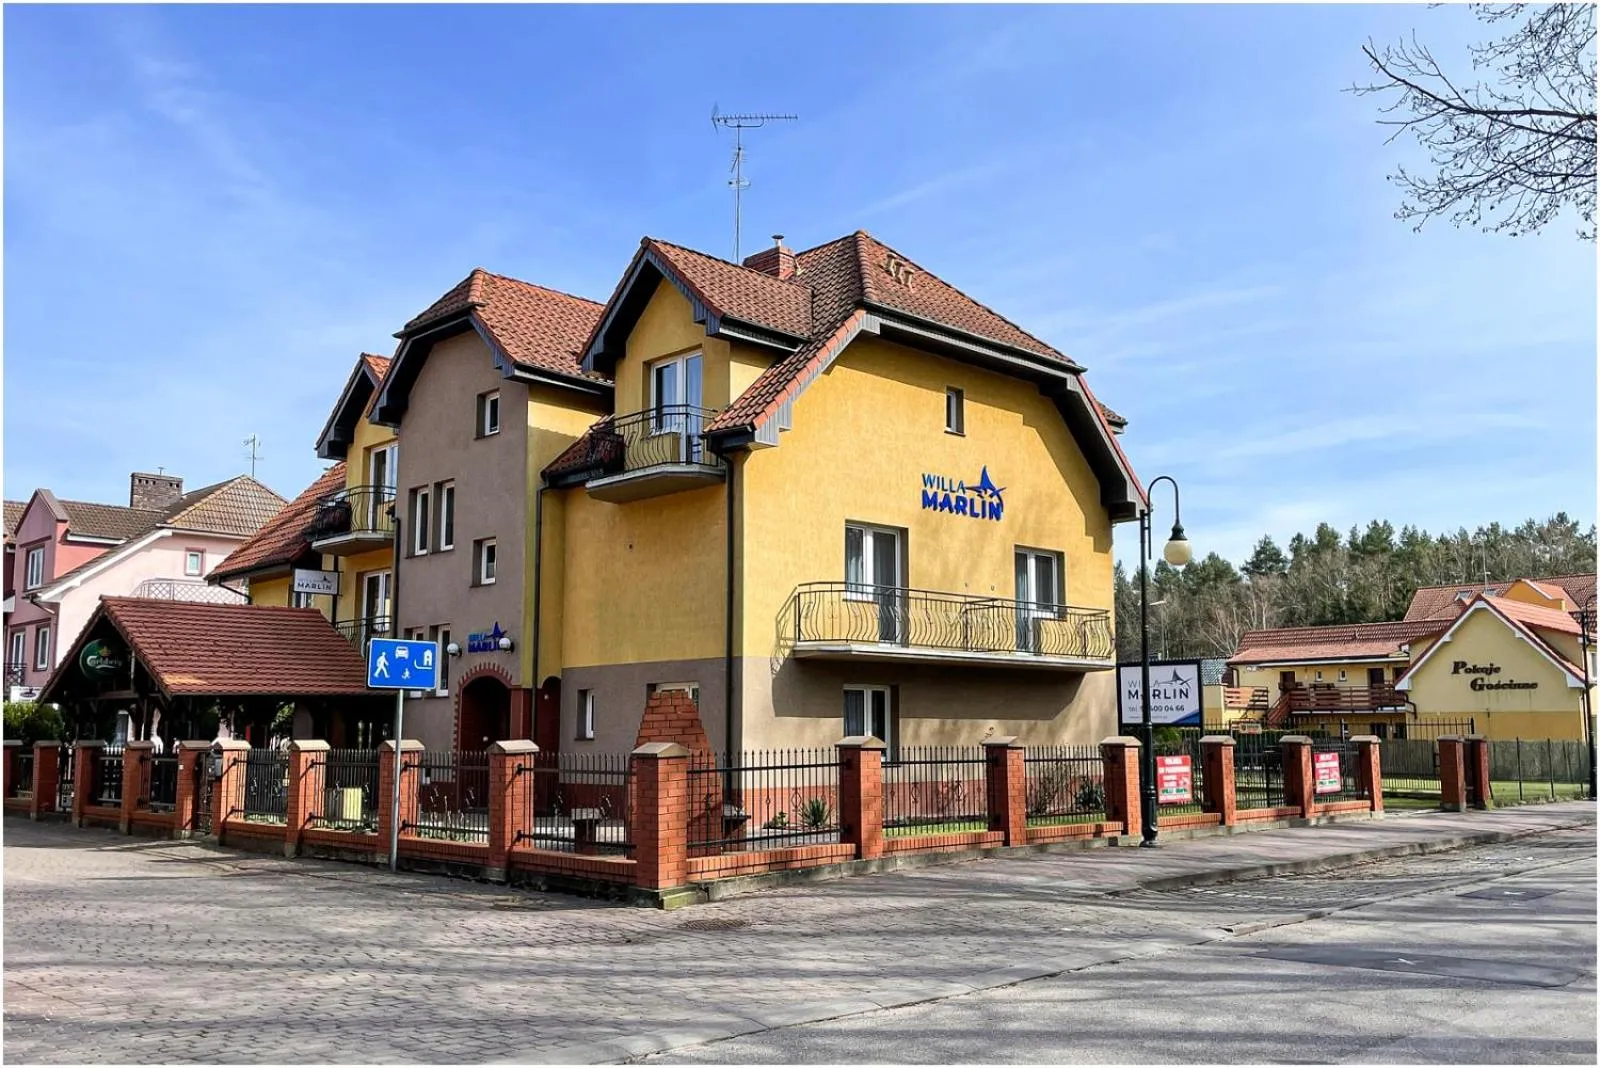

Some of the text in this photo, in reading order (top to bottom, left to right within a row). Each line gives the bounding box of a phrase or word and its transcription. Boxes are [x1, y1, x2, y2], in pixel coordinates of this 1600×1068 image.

[922, 473, 966, 494] WILLA
[922, 489, 1002, 521] MARLIN
[297, 582, 333, 591] MARLIN
[1128, 680, 1160, 688] WIA
[1128, 688, 1189, 700] MRLIN
